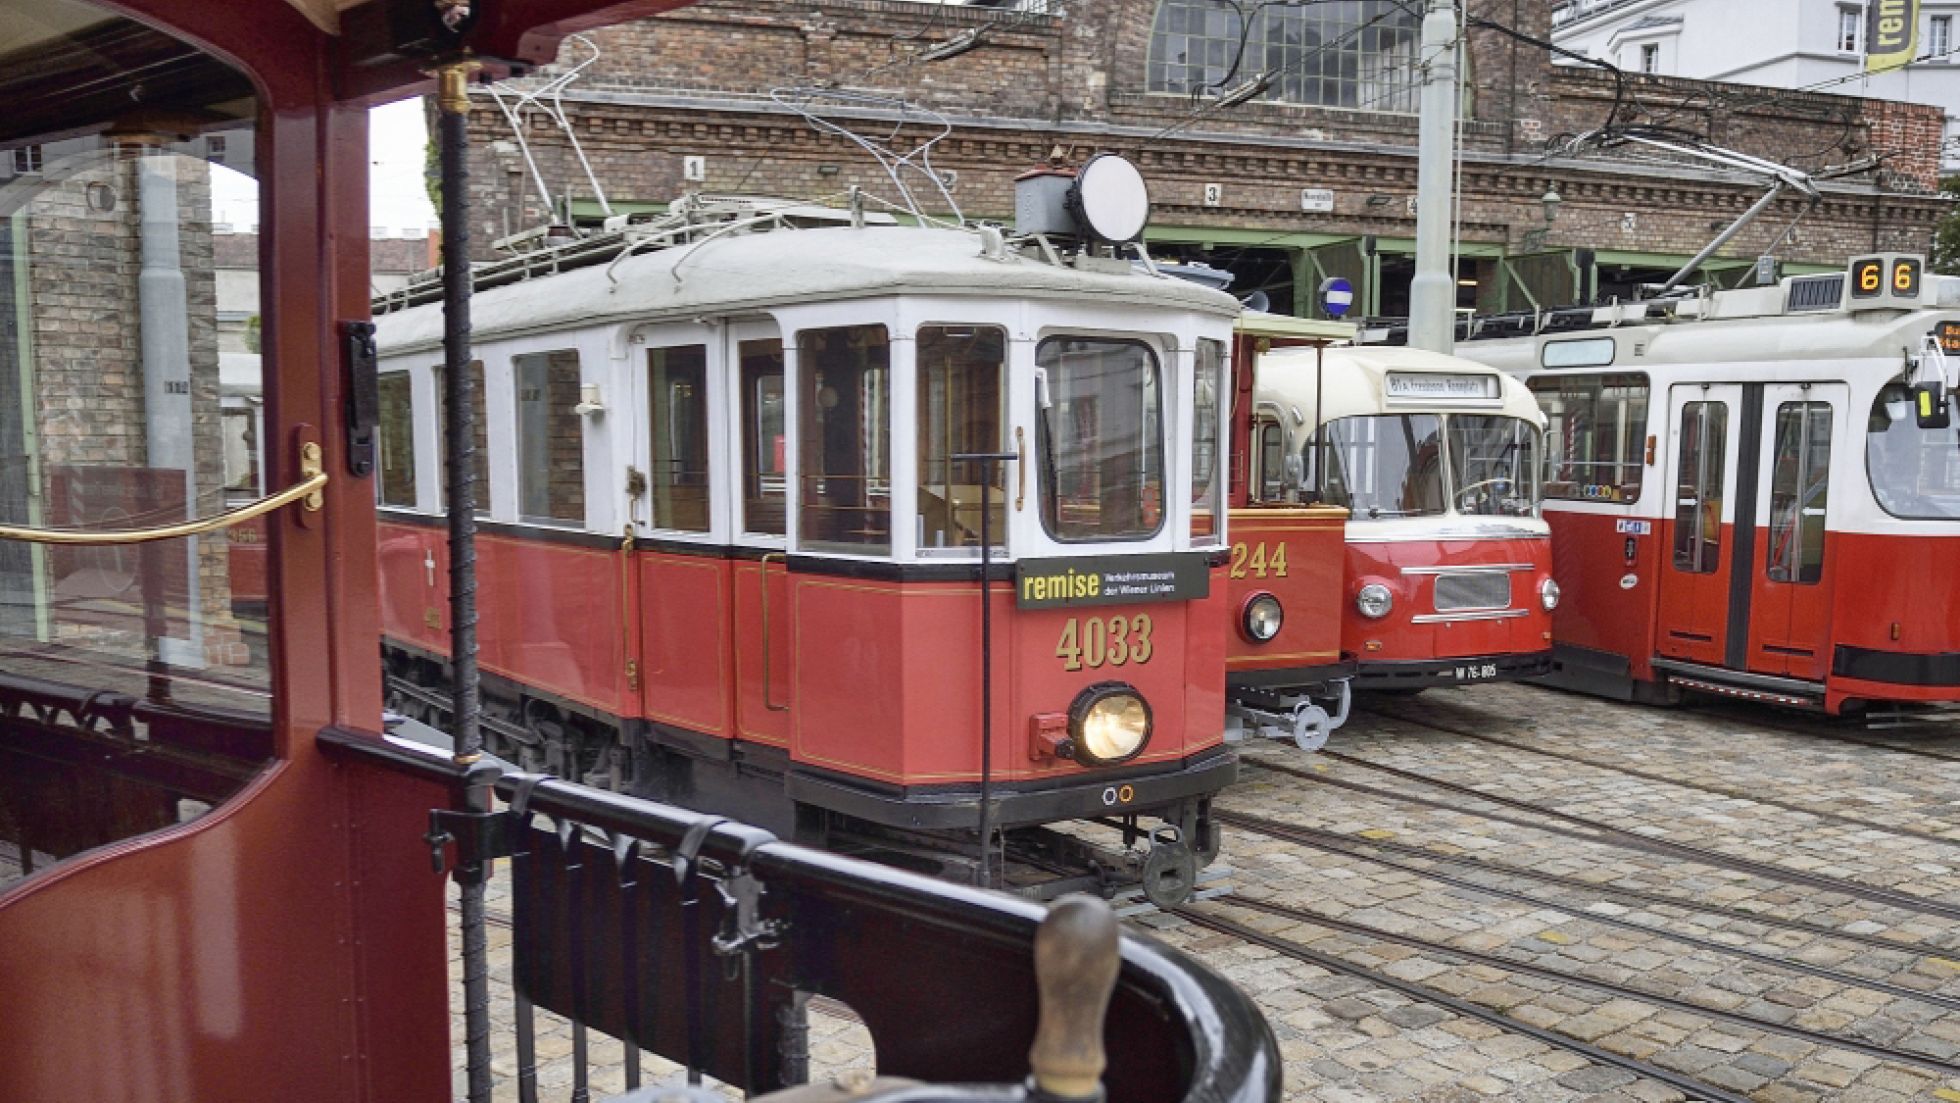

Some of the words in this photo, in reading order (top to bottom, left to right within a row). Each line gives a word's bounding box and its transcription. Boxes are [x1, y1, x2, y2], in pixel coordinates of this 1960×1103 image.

[1208, 187, 1217, 201] 3
[1230, 541, 1287, 579] 244
[1023, 567, 1100, 600] remise
[1104, 571, 1175, 583] Verkehrsmuseum
[1103, 586, 1118, 596] der
[1119, 584, 1148, 595] Wiener
[1150, 582, 1175, 593] Linien
[1056, 613, 1153, 671] 4033
